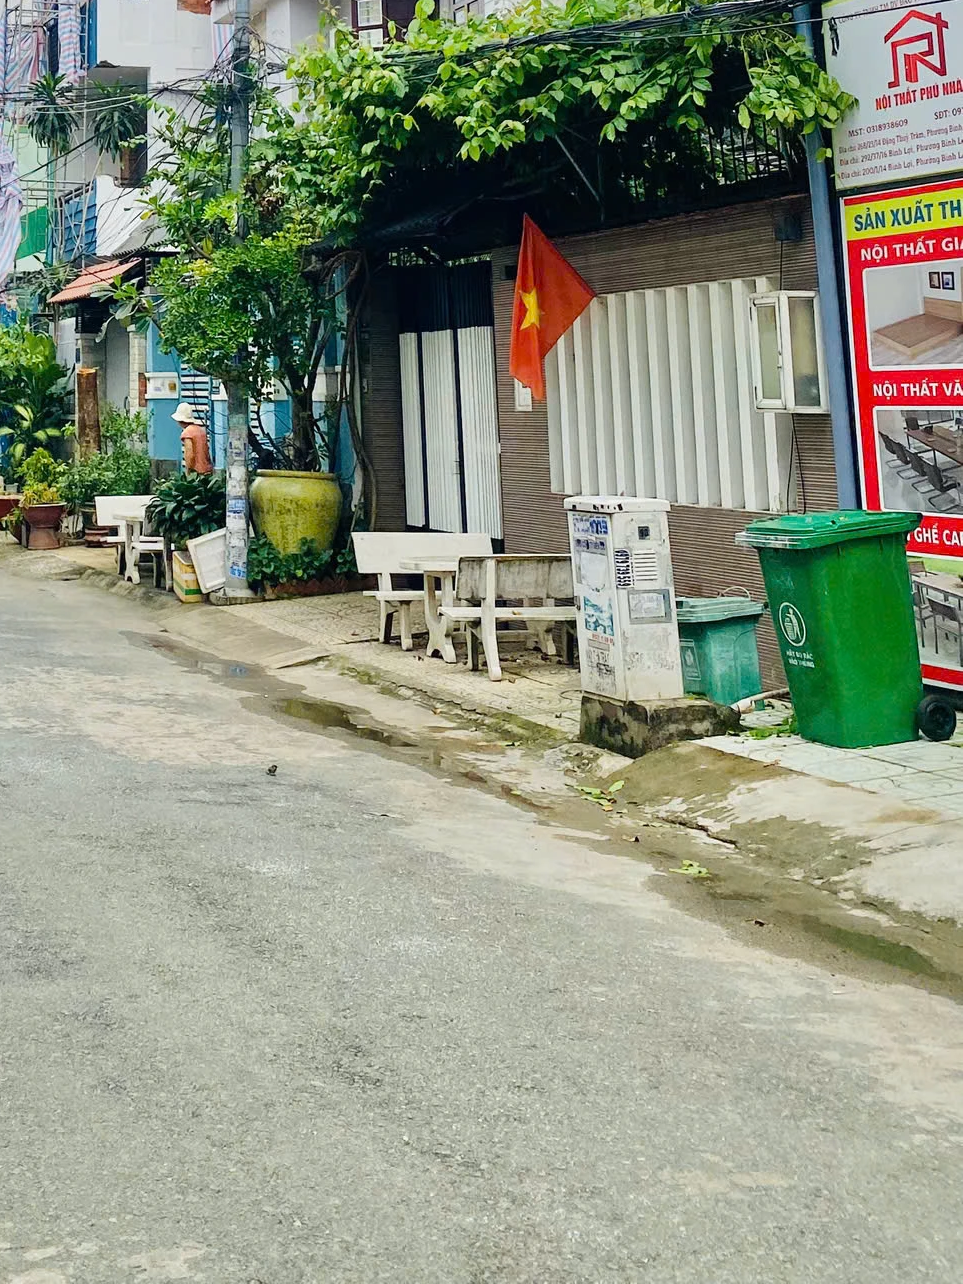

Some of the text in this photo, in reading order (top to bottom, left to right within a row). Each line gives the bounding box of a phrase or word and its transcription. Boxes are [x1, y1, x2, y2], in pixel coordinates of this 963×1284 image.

[875, 94, 892, 112] NỘI
[893, 86, 917, 107] THẤT
[920, 82, 940, 101] PHÚ
[854, 199, 962, 232] SẢN XUẤT TH
[860, 243, 888, 263] NỘI
[892, 235, 937, 258] THẤT
[873, 377, 963, 401] NỘI THẤT VĂ
[913, 522, 940, 545] GHẾ
